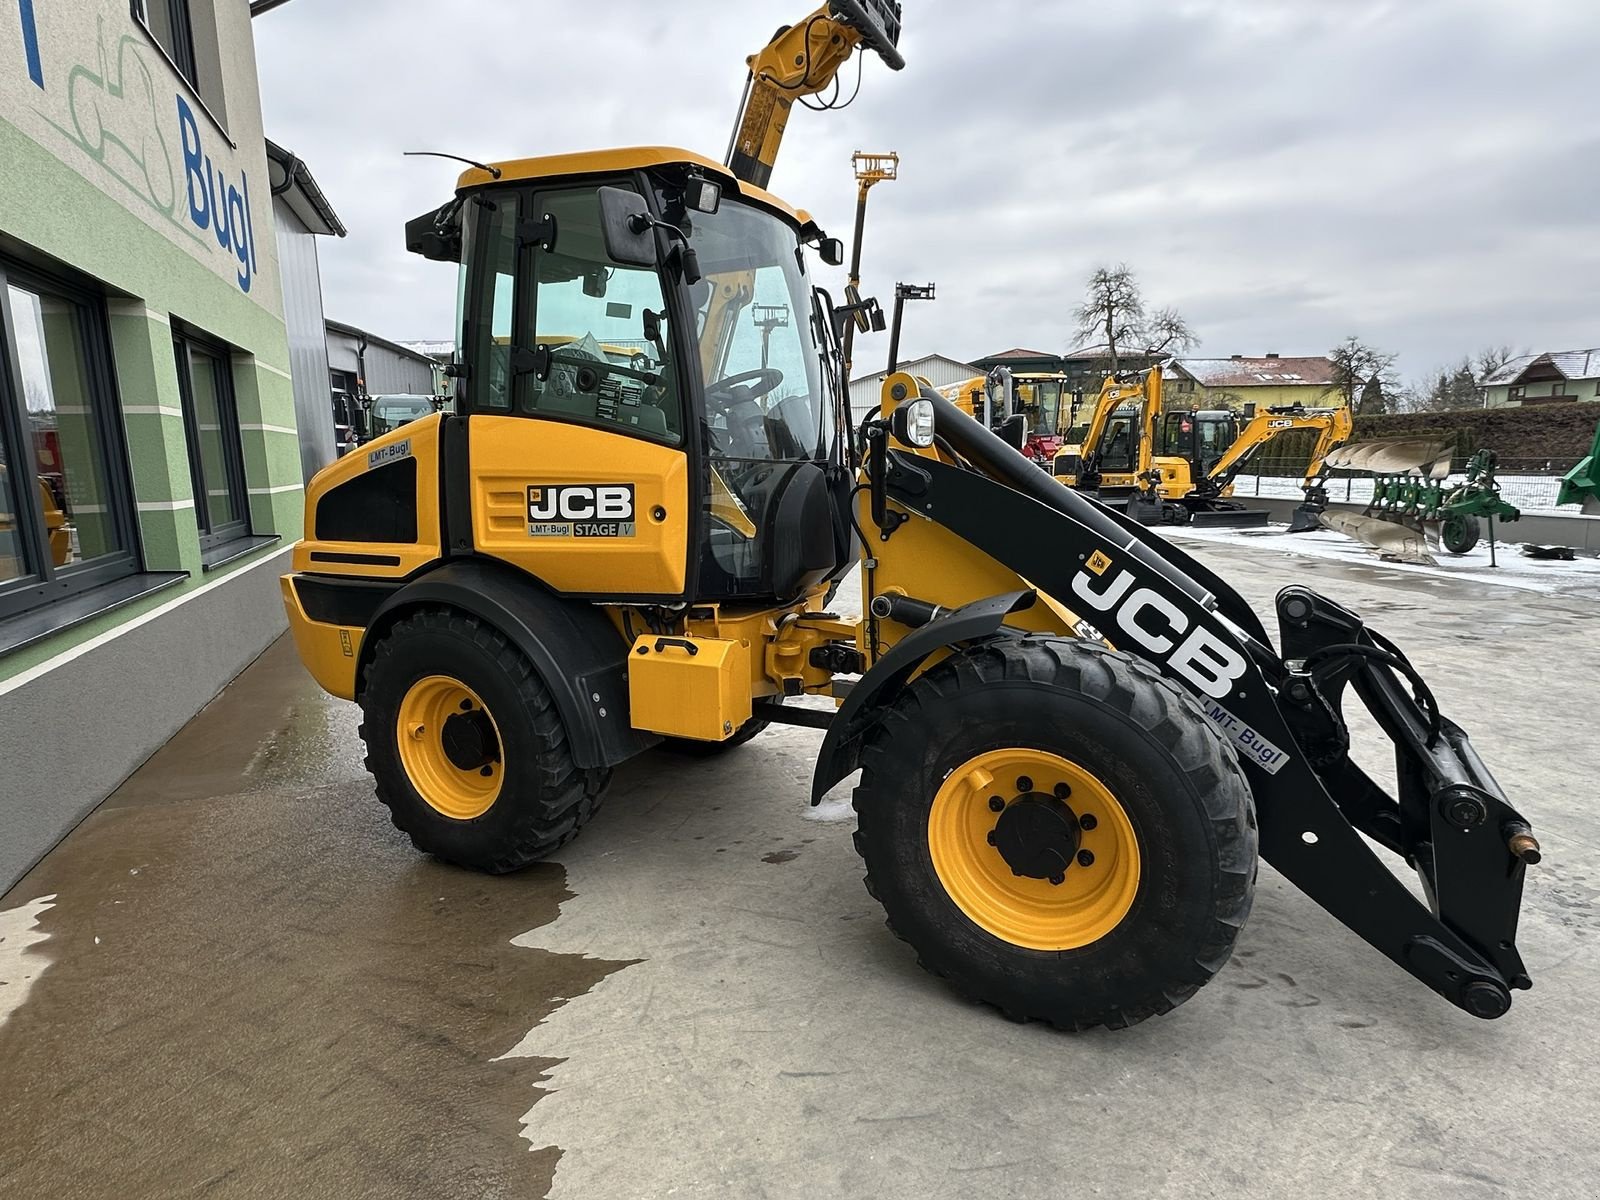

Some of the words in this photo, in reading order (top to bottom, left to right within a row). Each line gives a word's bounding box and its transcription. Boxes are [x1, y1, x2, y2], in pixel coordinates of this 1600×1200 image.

[176, 93, 257, 293] Bugl
[1268, 420, 1293, 428] JCB
[370, 440, 409, 463] LMT-Bugl
[530, 487, 632, 519] JCB
[530, 524, 569, 535] LMT-Bugl
[575, 523, 617, 536] STAGE
[623, 524, 633, 535] V
[1071, 568, 1247, 698] JCB
